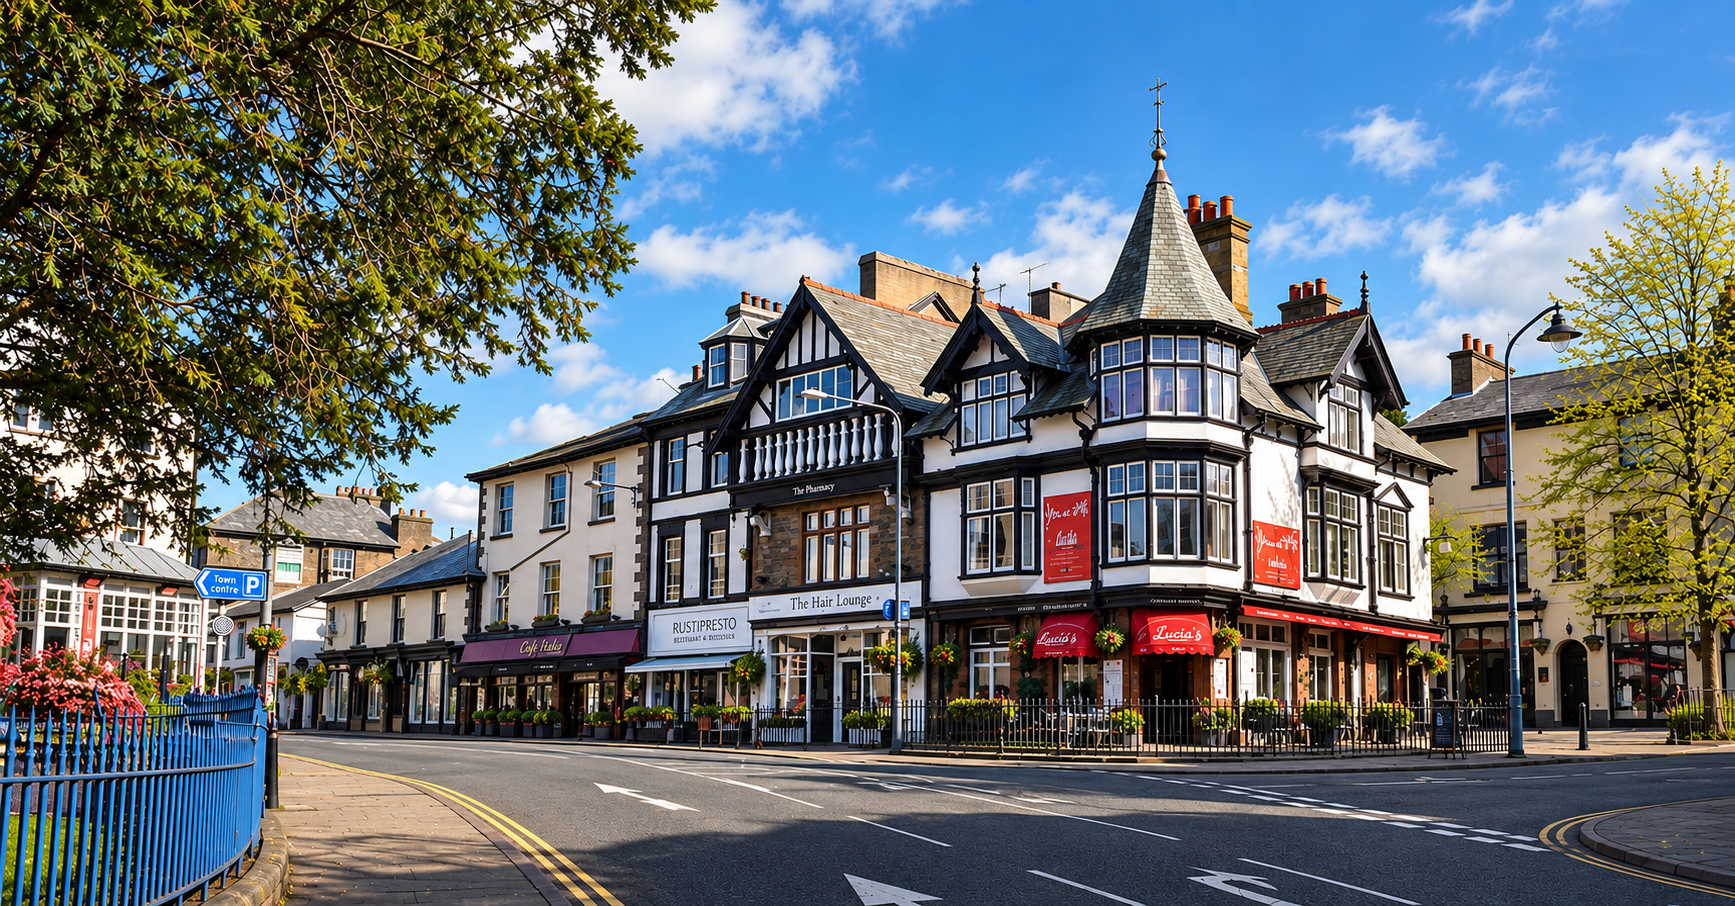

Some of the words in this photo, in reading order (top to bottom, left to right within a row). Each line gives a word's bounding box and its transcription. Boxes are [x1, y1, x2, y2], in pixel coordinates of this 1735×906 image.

[792, 486, 804, 496] The
[805, 484, 835, 493] Pharmacy
[214, 574, 236, 584] Town
[246, 576, 260, 594] P
[790, 596, 809, 610] The
[811, 596, 833, 609] Hair
[836, 594, 872, 608] Lounge
[673, 617, 737, 634] RUSTIPRESTO
[1152, 625, 1202, 641] Lucia's
